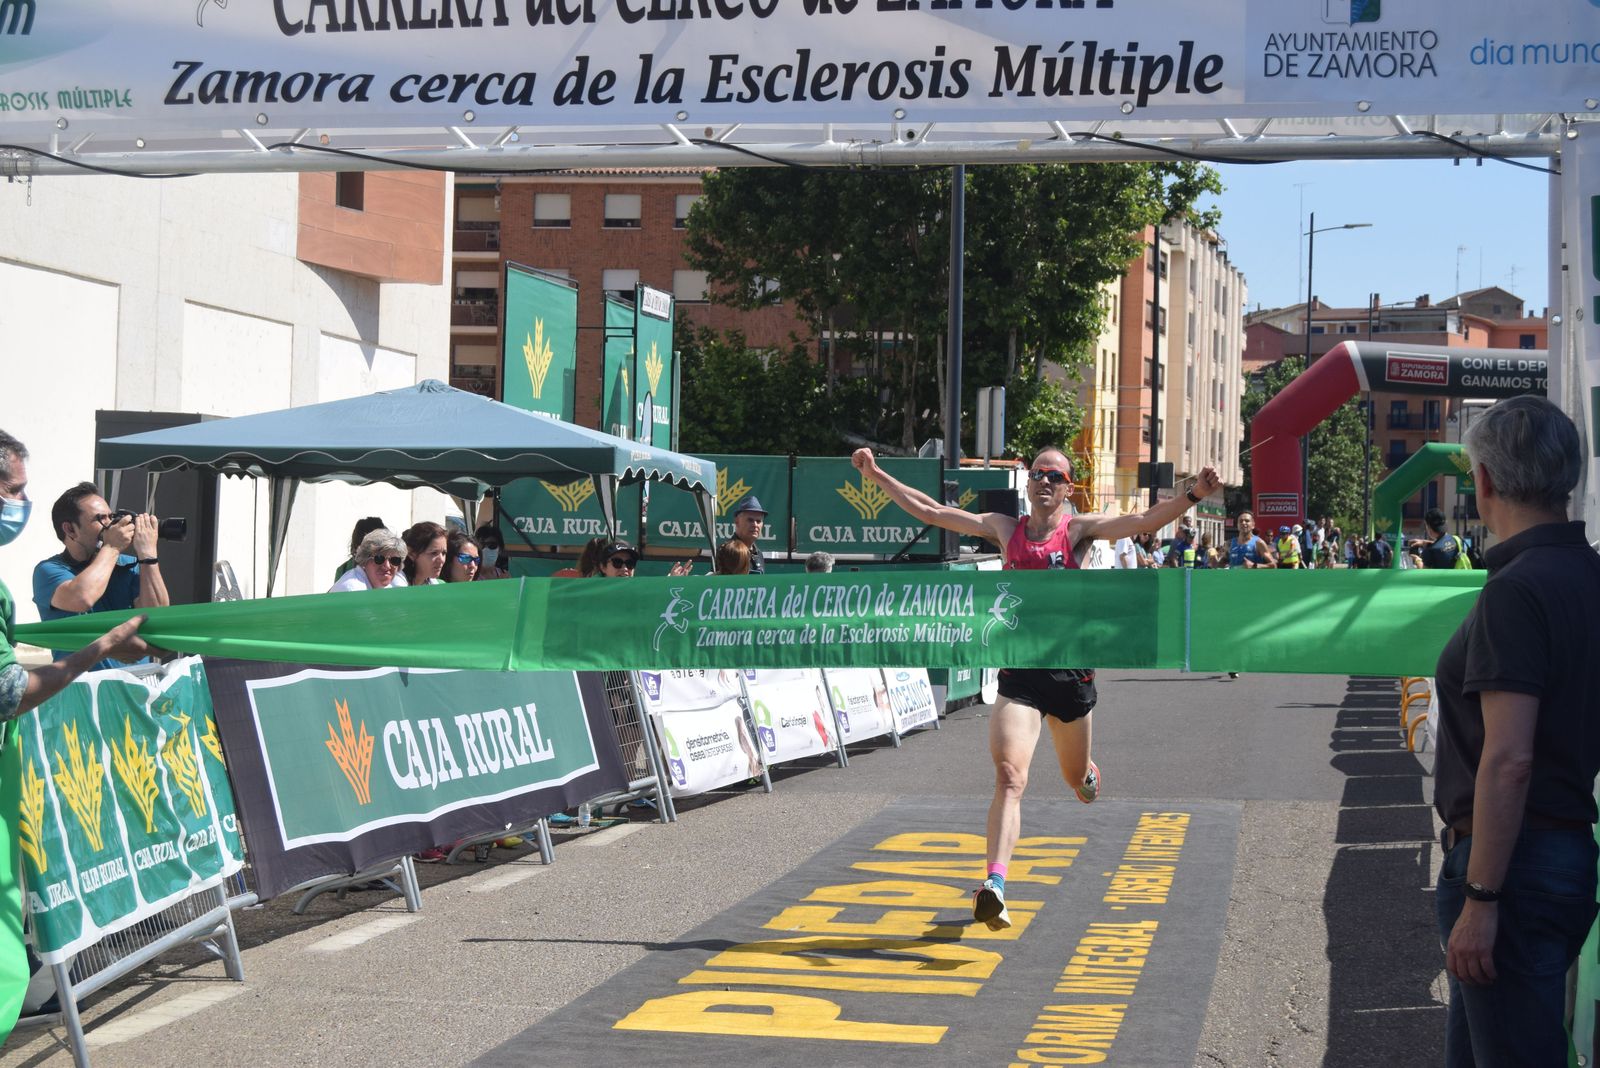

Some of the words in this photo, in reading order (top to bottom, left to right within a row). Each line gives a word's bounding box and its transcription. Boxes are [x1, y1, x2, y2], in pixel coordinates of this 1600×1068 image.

[1264, 30, 1438, 52] AYUNTAMIENTO
[1470, 37, 1514, 66] dia
[164, 60, 376, 105] Zamora
[389, 71, 536, 106] cerca
[552, 56, 617, 106] de
[634, 53, 683, 104] la
[701, 45, 972, 104] Esclerosis
[988, 40, 1224, 107] Múltiple
[1264, 54, 1298, 78] DE
[1307, 53, 1437, 78] ZAMORA
[57, 86, 132, 110] MÚLTIPLE
[1401, 368, 1445, 380] ZAMORA
[1461, 357, 1493, 370] CON
[1497, 359, 1514, 371] EL
[1461, 374, 1532, 389] GANAMOS
[1266, 505, 1297, 513] ZAMORA
[513, 516, 557, 534] CAJA
[658, 520, 705, 538] CAJA
[714, 522, 777, 540] RUL
[809, 525, 857, 543] CAJA
[862, 526, 930, 543] RURAL
[698, 586, 777, 621] CARRERA
[781, 584, 810, 619] del
[812, 584, 872, 618] CERCO
[874, 582, 896, 617] de
[898, 583, 976, 618] ZAMORA
[696, 626, 753, 647] Zamora
[756, 629, 796, 646] cerca
[799, 623, 817, 644] de
[820, 623, 836, 644] la
[838, 622, 910, 644] Esclerosis
[913, 621, 974, 648] Múltiple
[890, 678, 932, 717] OCEANIC
[383, 717, 464, 791] CAJA
[454, 702, 555, 777] RURAL
[1122, 812, 1191, 862] INTERIORES
[80, 866, 102, 894] CAJA
[98, 857, 129, 885] RURAL
[1102, 864, 1177, 904] DISEÑO
[46, 879, 76, 910] URAL
[612, 832, 1088, 1045] PIDEPAR
[1053, 920, 1160, 995] INTEGRAL
